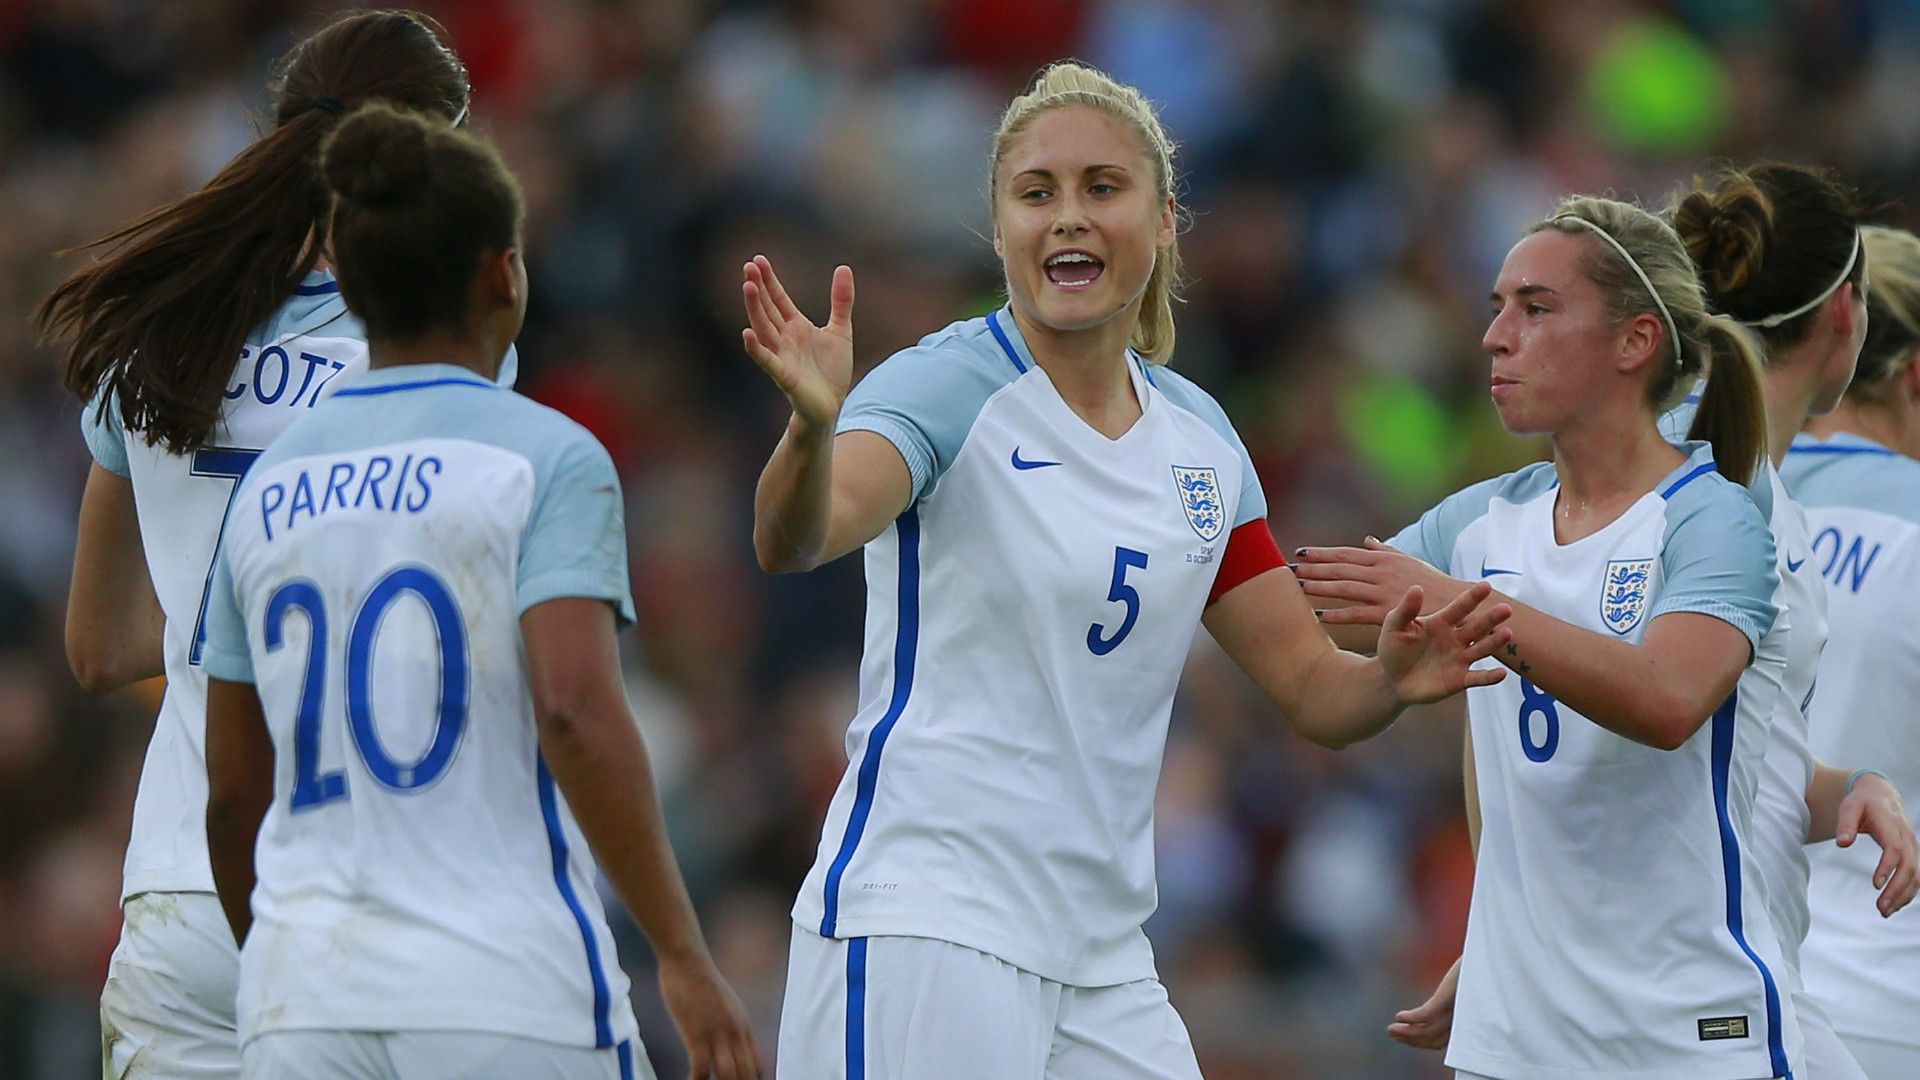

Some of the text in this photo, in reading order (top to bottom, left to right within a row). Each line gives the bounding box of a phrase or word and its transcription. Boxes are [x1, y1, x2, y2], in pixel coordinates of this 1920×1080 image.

[223, 345, 346, 408] COTT
[261, 453, 443, 542] PARRIS
[1087, 545, 1149, 655] 5
[264, 563, 470, 814] 20
[1518, 676, 1559, 763] 8
